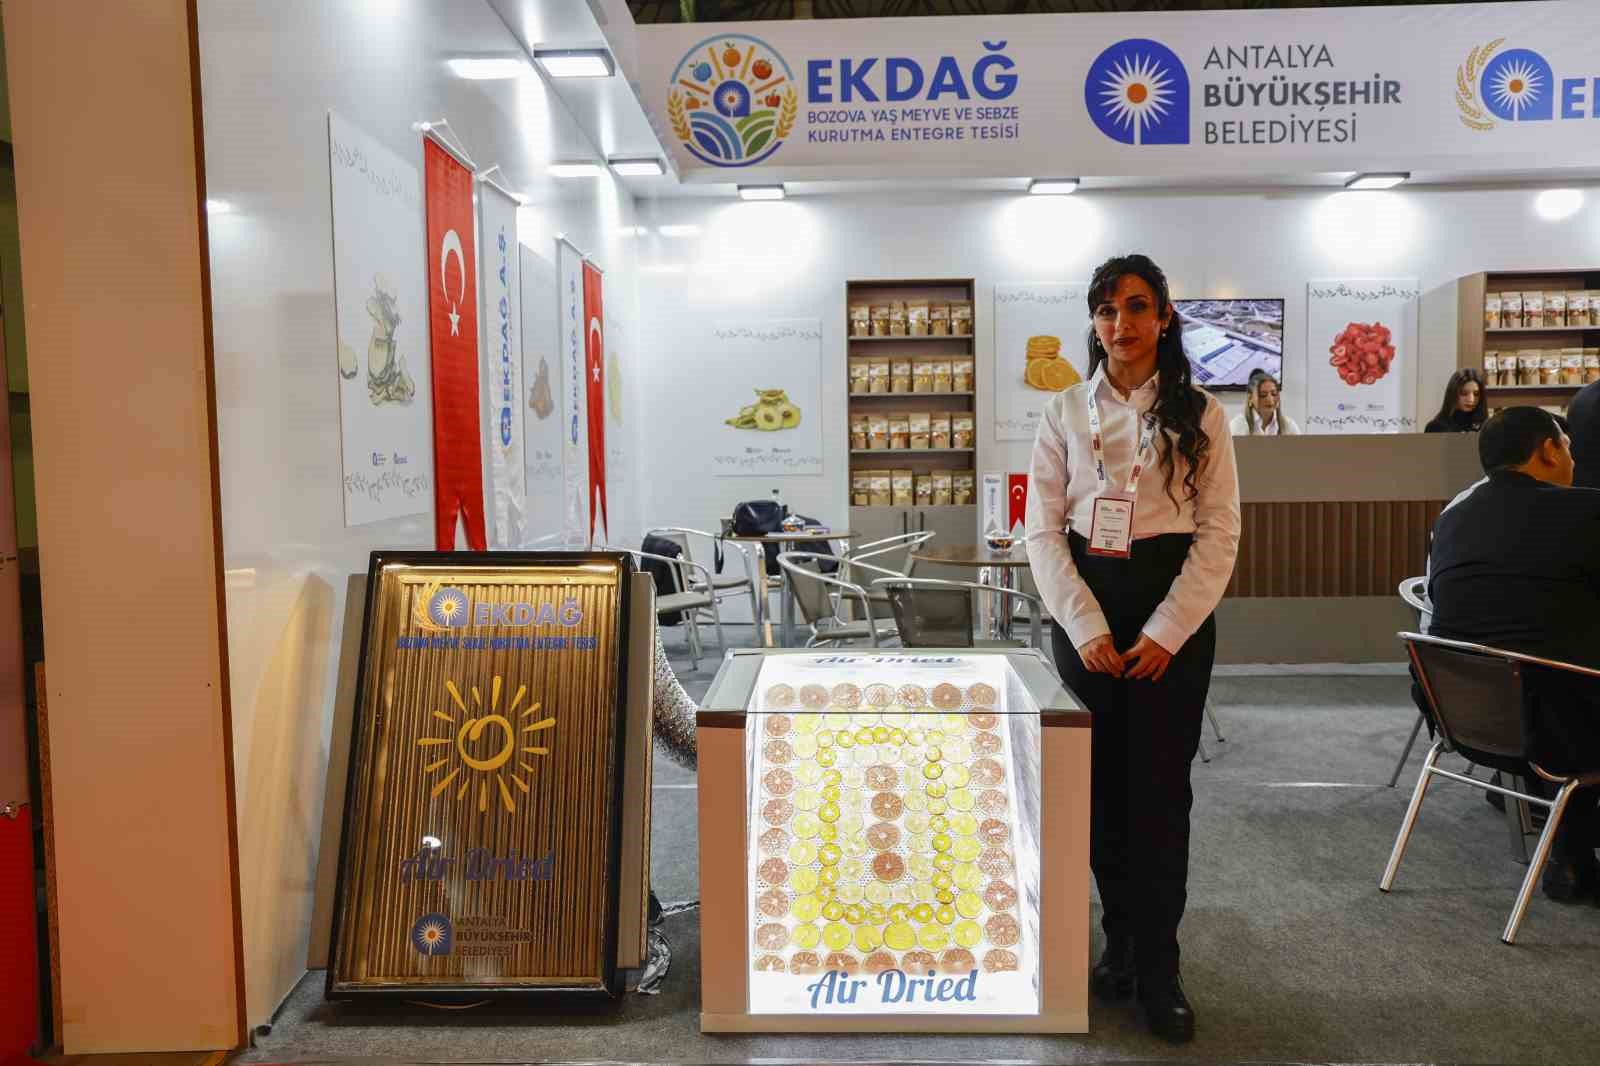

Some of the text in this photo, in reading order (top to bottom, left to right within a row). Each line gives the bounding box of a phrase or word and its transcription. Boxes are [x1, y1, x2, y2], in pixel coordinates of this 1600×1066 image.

[807, 41, 1018, 103] EKDAĞ
[1203, 44, 1334, 70] ANTALYA
[1204, 73, 1402, 112] BÜYÜKŞEHİR
[1561, 77, 1600, 120] E
[808, 106, 1019, 126] BOZOVA YAŞ MEYVE VE SEBZE
[1204, 112, 1357, 144] BELEDİYESİ
[808, 123, 1019, 143] KURUTMA ENTEGRE TESİSİ
[475, 597, 582, 627] EKDAĞ
[806, 968, 978, 1009] Air Dried
